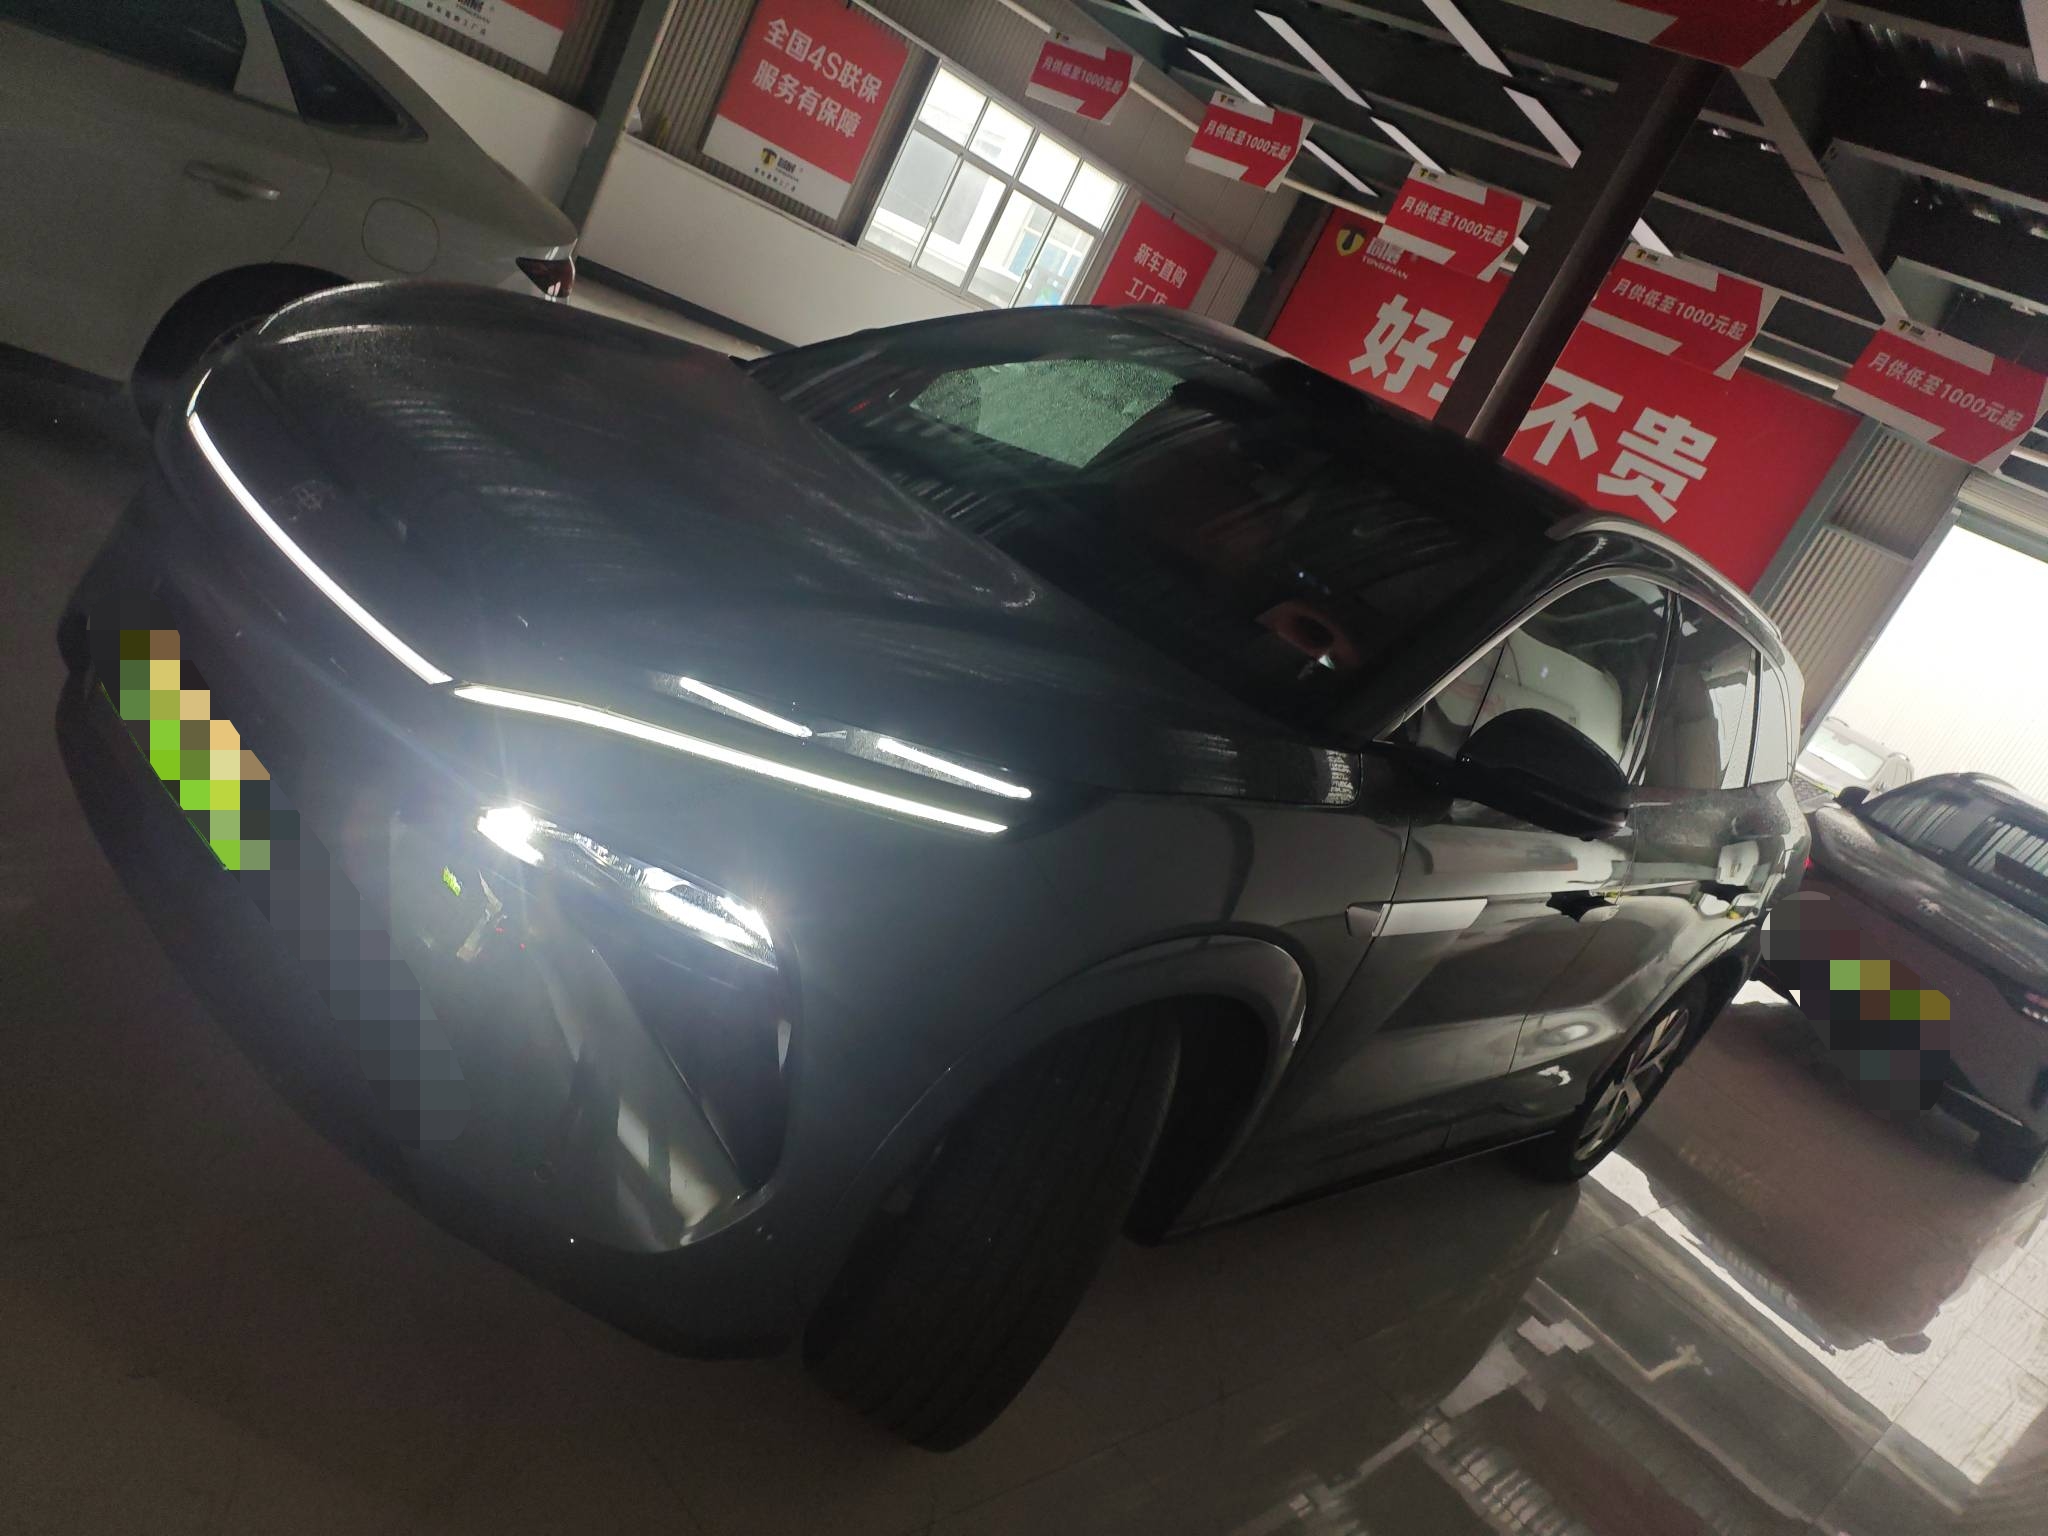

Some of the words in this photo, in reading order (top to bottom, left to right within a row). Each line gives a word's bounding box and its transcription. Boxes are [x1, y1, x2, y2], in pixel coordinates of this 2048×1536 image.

[763, 18, 882, 104] 全国4S联保
[1042, 56, 1124, 95] 月供低至1000元起
[752, 59, 862, 138] 服务有保障
[1204, 120, 1292, 160] 月供低至1000元起
[1401, 196, 1508, 247] 月供低至1000元起
[1134, 243, 1187, 289] 新车直购
[1612, 278, 1748, 341] 月供低至1000元起
[1868, 352, 2024, 431] 月供低至1000元起
